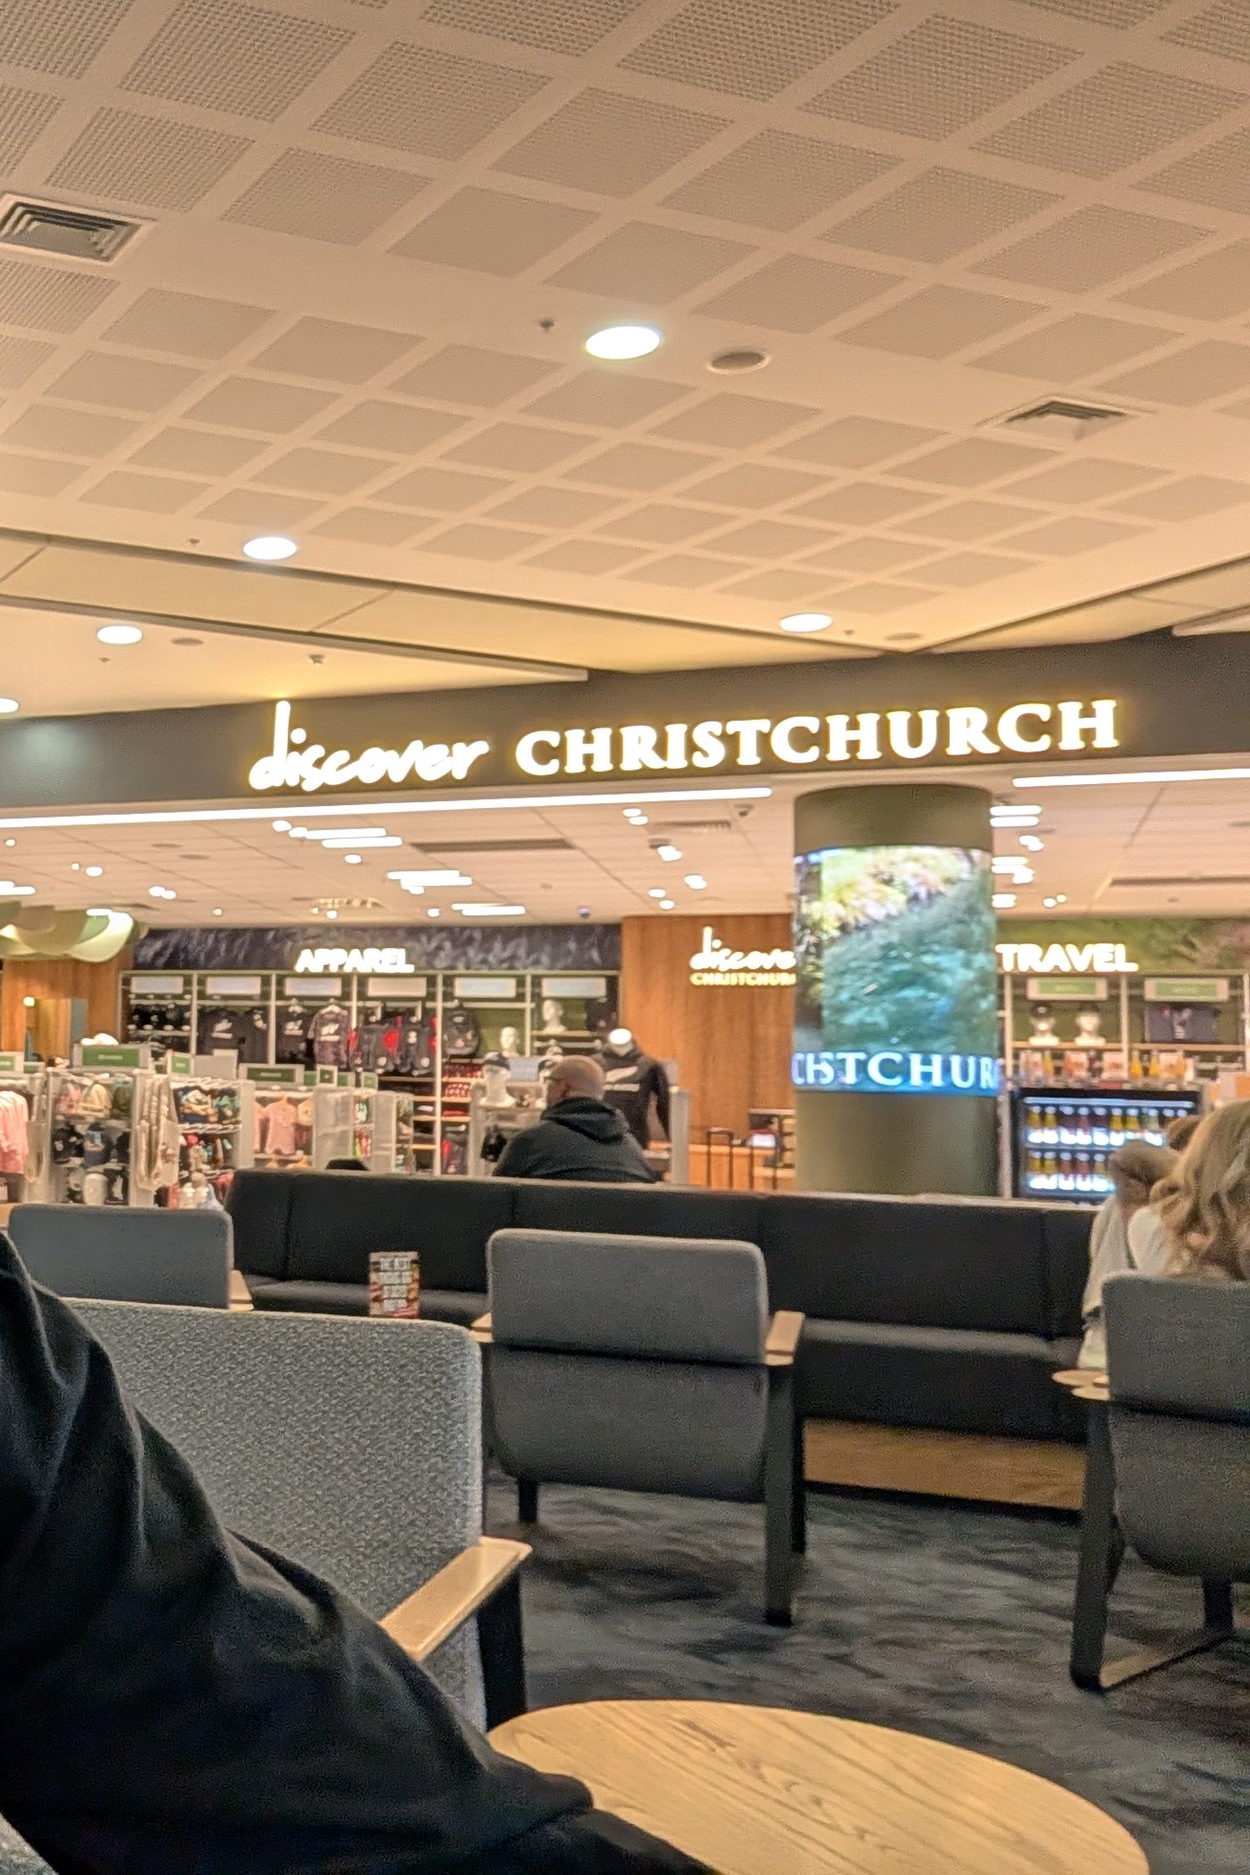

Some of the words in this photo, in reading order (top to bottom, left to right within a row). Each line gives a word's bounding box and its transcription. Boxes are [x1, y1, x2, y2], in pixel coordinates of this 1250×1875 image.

[249, 700, 489, 790] discover
[515, 700, 1119, 776] CHRISTCHURCH
[294, 948, 415, 973] APPAREL
[690, 926, 796, 971] discove
[995, 943, 1139, 972] TRAVEL
[690, 973, 796, 986] CHRISTCHUR
